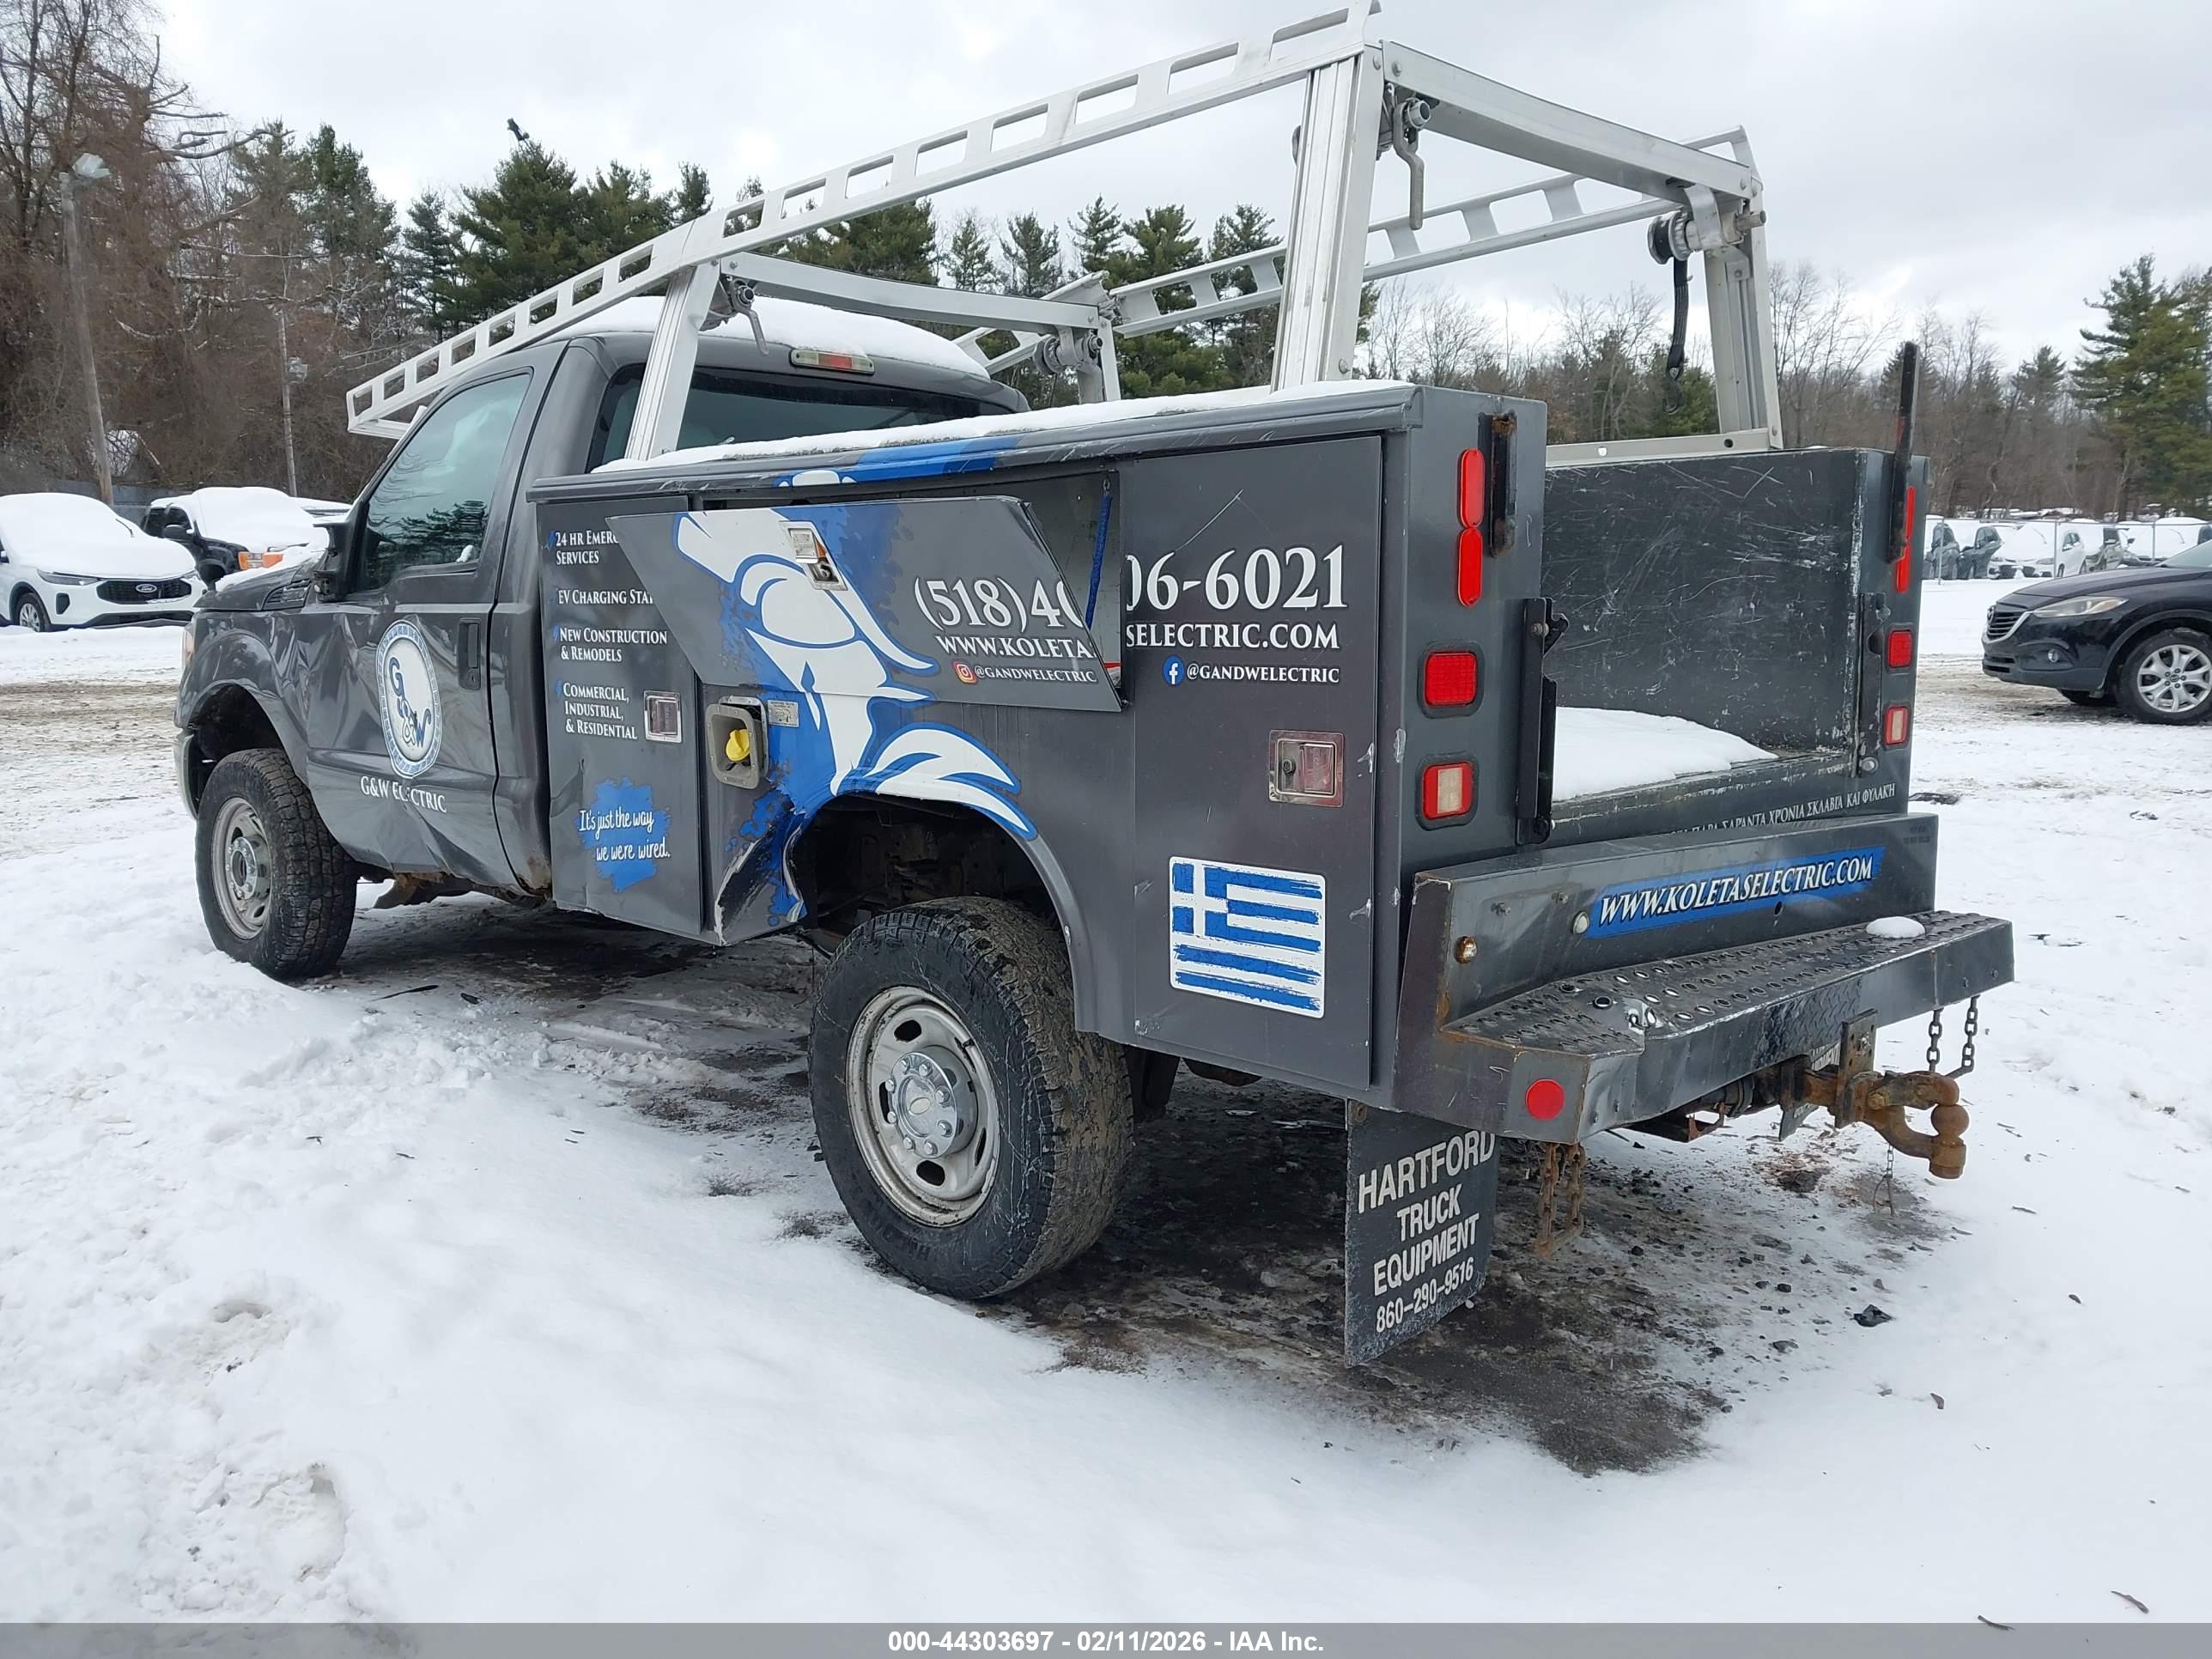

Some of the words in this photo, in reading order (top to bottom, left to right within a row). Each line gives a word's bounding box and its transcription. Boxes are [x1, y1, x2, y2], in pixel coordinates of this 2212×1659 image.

[555, 532, 567, 547] 24
[556, 550, 599, 565] SERVICES
[558, 589, 571, 605] EV
[572, 589, 627, 605] CHARGING
[559, 627, 581, 642] NEW
[583, 627, 668, 645] CONSTRUCTION
[934, 635, 1098, 659] WWW.KOLETA
[560, 645, 570, 660] &
[571, 646, 623, 662] REMODELS
[974, 665, 1098, 684] @GANDWELECTRIC
[1187, 663, 1340, 684] @GANDWELECTRIC
[562, 682, 629, 703] COMMERCIAL,
[564, 700, 624, 722] INDUSTRIAL,
[565, 719, 575, 733] &
[576, 720, 638, 739] RESIDENTIAL
[360, 775, 390, 799] G&W
[579, 809, 596, 832] It's
[595, 810, 616, 840] just
[615, 805, 632, 829] the
[633, 811, 655, 834] way
[596, 846, 610, 861] we
[611, 844, 635, 860] were
[638, 836, 671, 860] wired.
[1598, 854, 1875, 927] WWW.KOLETASELECTRIC.COM
[1358, 1129, 1497, 1214] HARTFORD
[1395, 1182, 1463, 1243] TRUCK
[1373, 1212, 1480, 1297] EQUIPMENT
[1375, 1255, 1475, 1334] 860-290-9516
